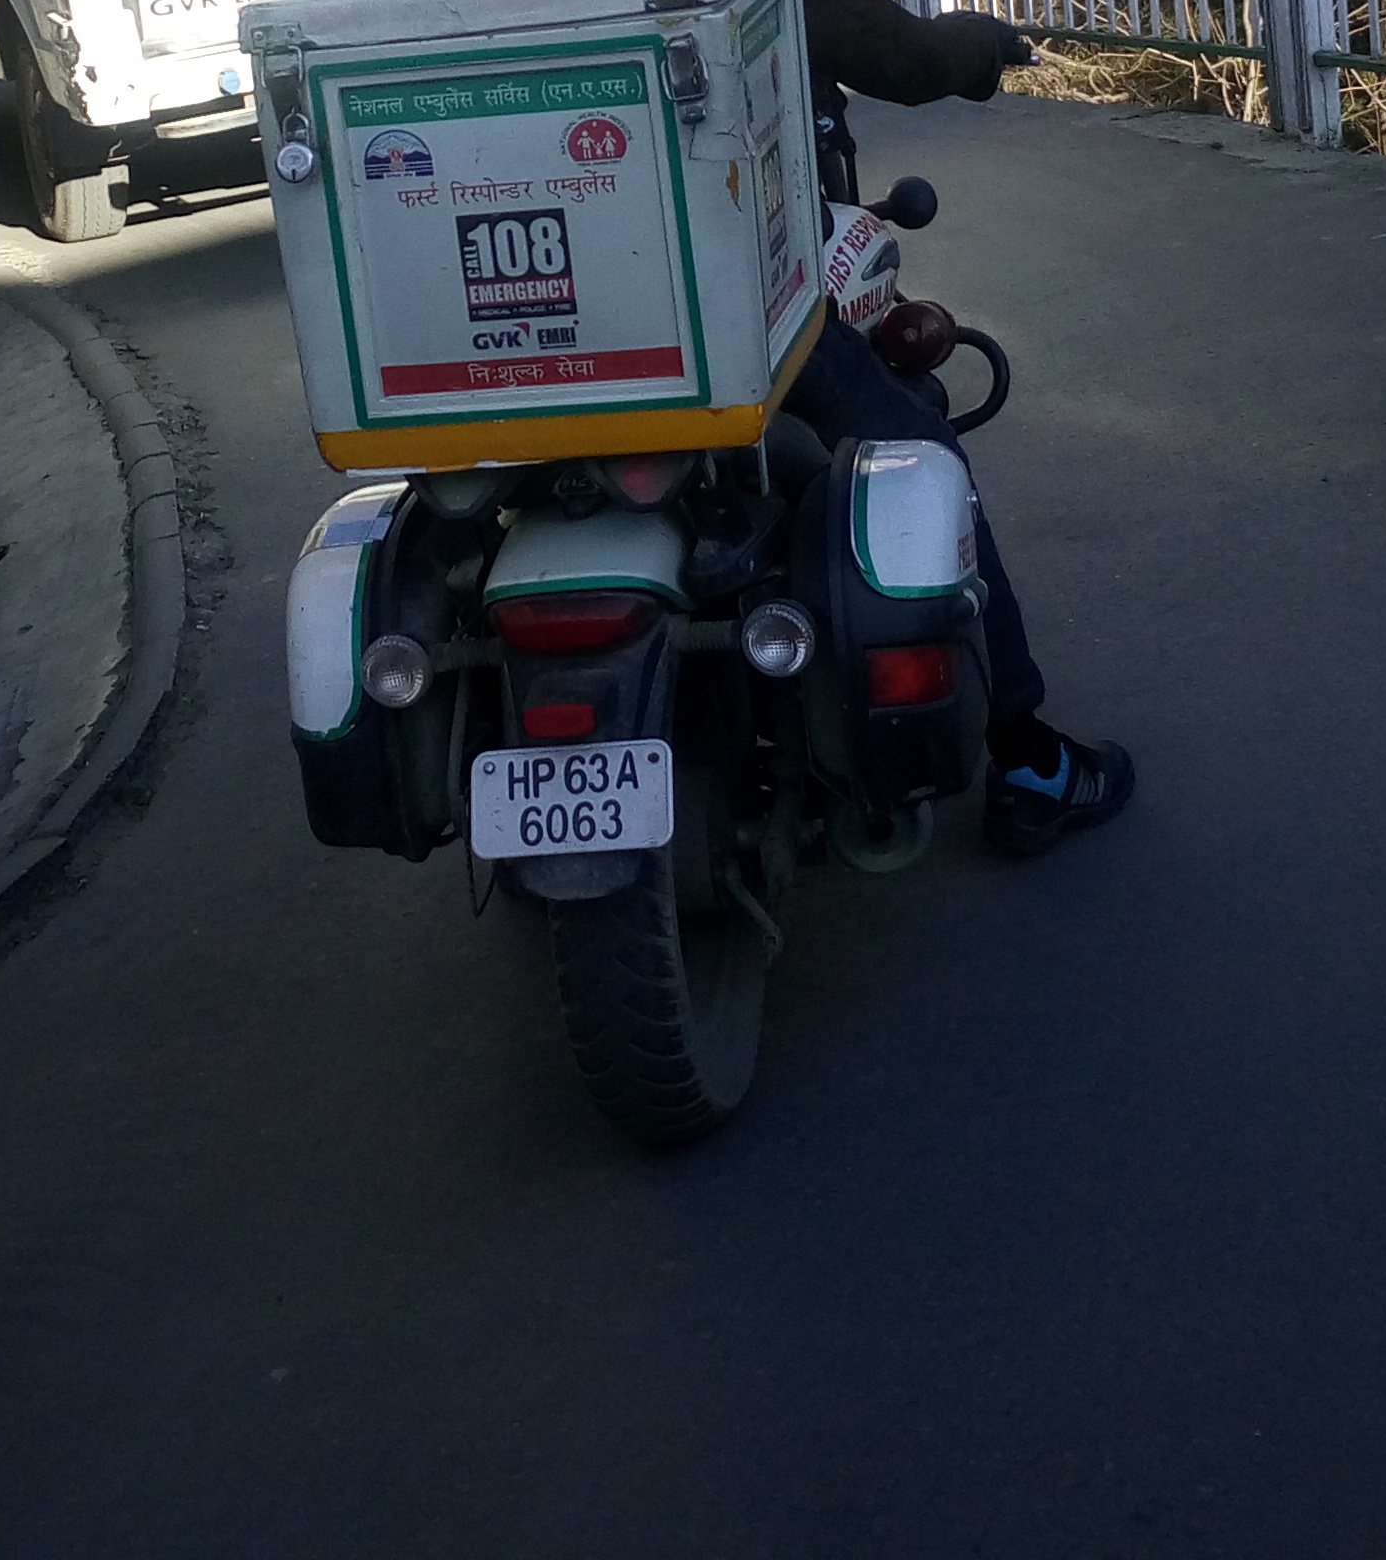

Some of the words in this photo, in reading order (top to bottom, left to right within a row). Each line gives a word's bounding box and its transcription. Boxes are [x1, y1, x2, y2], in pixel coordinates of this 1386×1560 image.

[350, 95, 403, 117] नेशनल
[484, 81, 530, 104] सर्विस
[398, 181, 438, 208] फर्स्ट
[463, 245, 481, 279] CALL
[467, 217, 566, 279] 108
[825, 244, 855, 297] FIRST
[469, 278, 570, 304] EMERGENCY
[472, 329, 523, 350] GVK
[555, 357, 595, 378] सेवा
[520, 798, 623, 846] 6063
